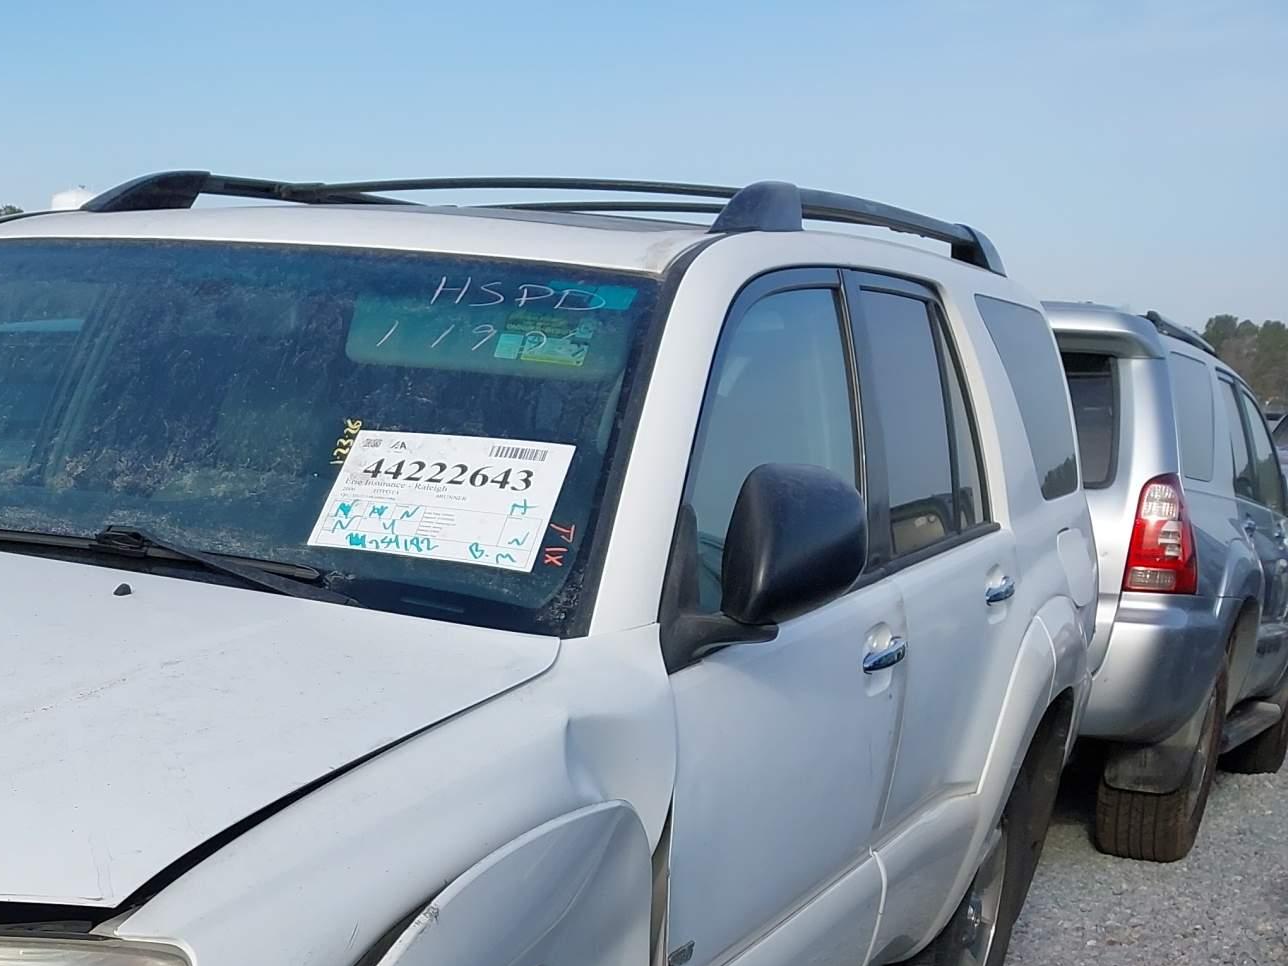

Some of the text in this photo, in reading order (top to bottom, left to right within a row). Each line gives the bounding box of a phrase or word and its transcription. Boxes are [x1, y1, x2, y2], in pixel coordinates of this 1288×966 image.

[430, 276, 606, 310] HSPD
[362, 457, 534, 491] 44222643
[363, 478, 406, 489] Insurance
[414, 482, 448, 493] Raleigh
